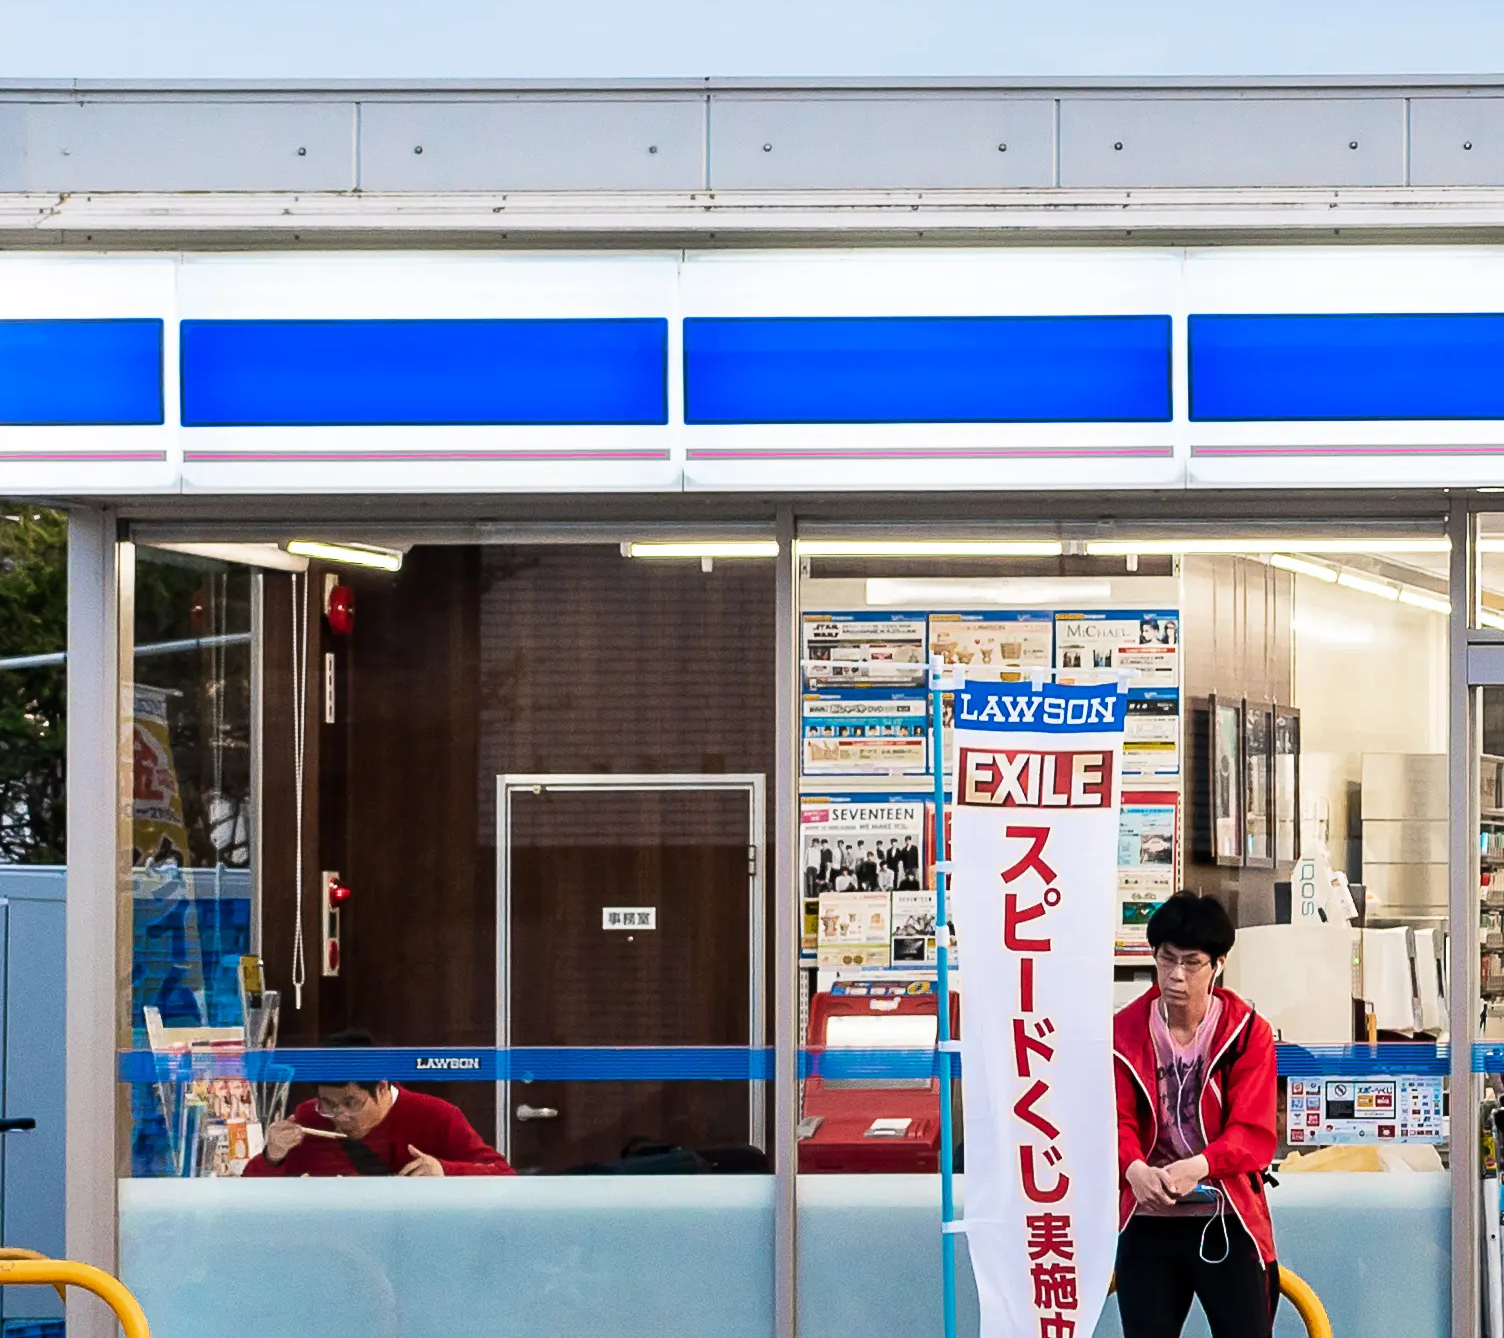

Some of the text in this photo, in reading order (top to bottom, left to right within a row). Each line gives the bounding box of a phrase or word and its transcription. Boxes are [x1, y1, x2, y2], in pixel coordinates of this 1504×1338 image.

[960, 693, 1117, 725] LAWSON
[965, 751, 1104, 806] EXILE
[832, 808, 915, 821] SEVENTEEN
[416, 1057, 480, 1069] LAWSON
